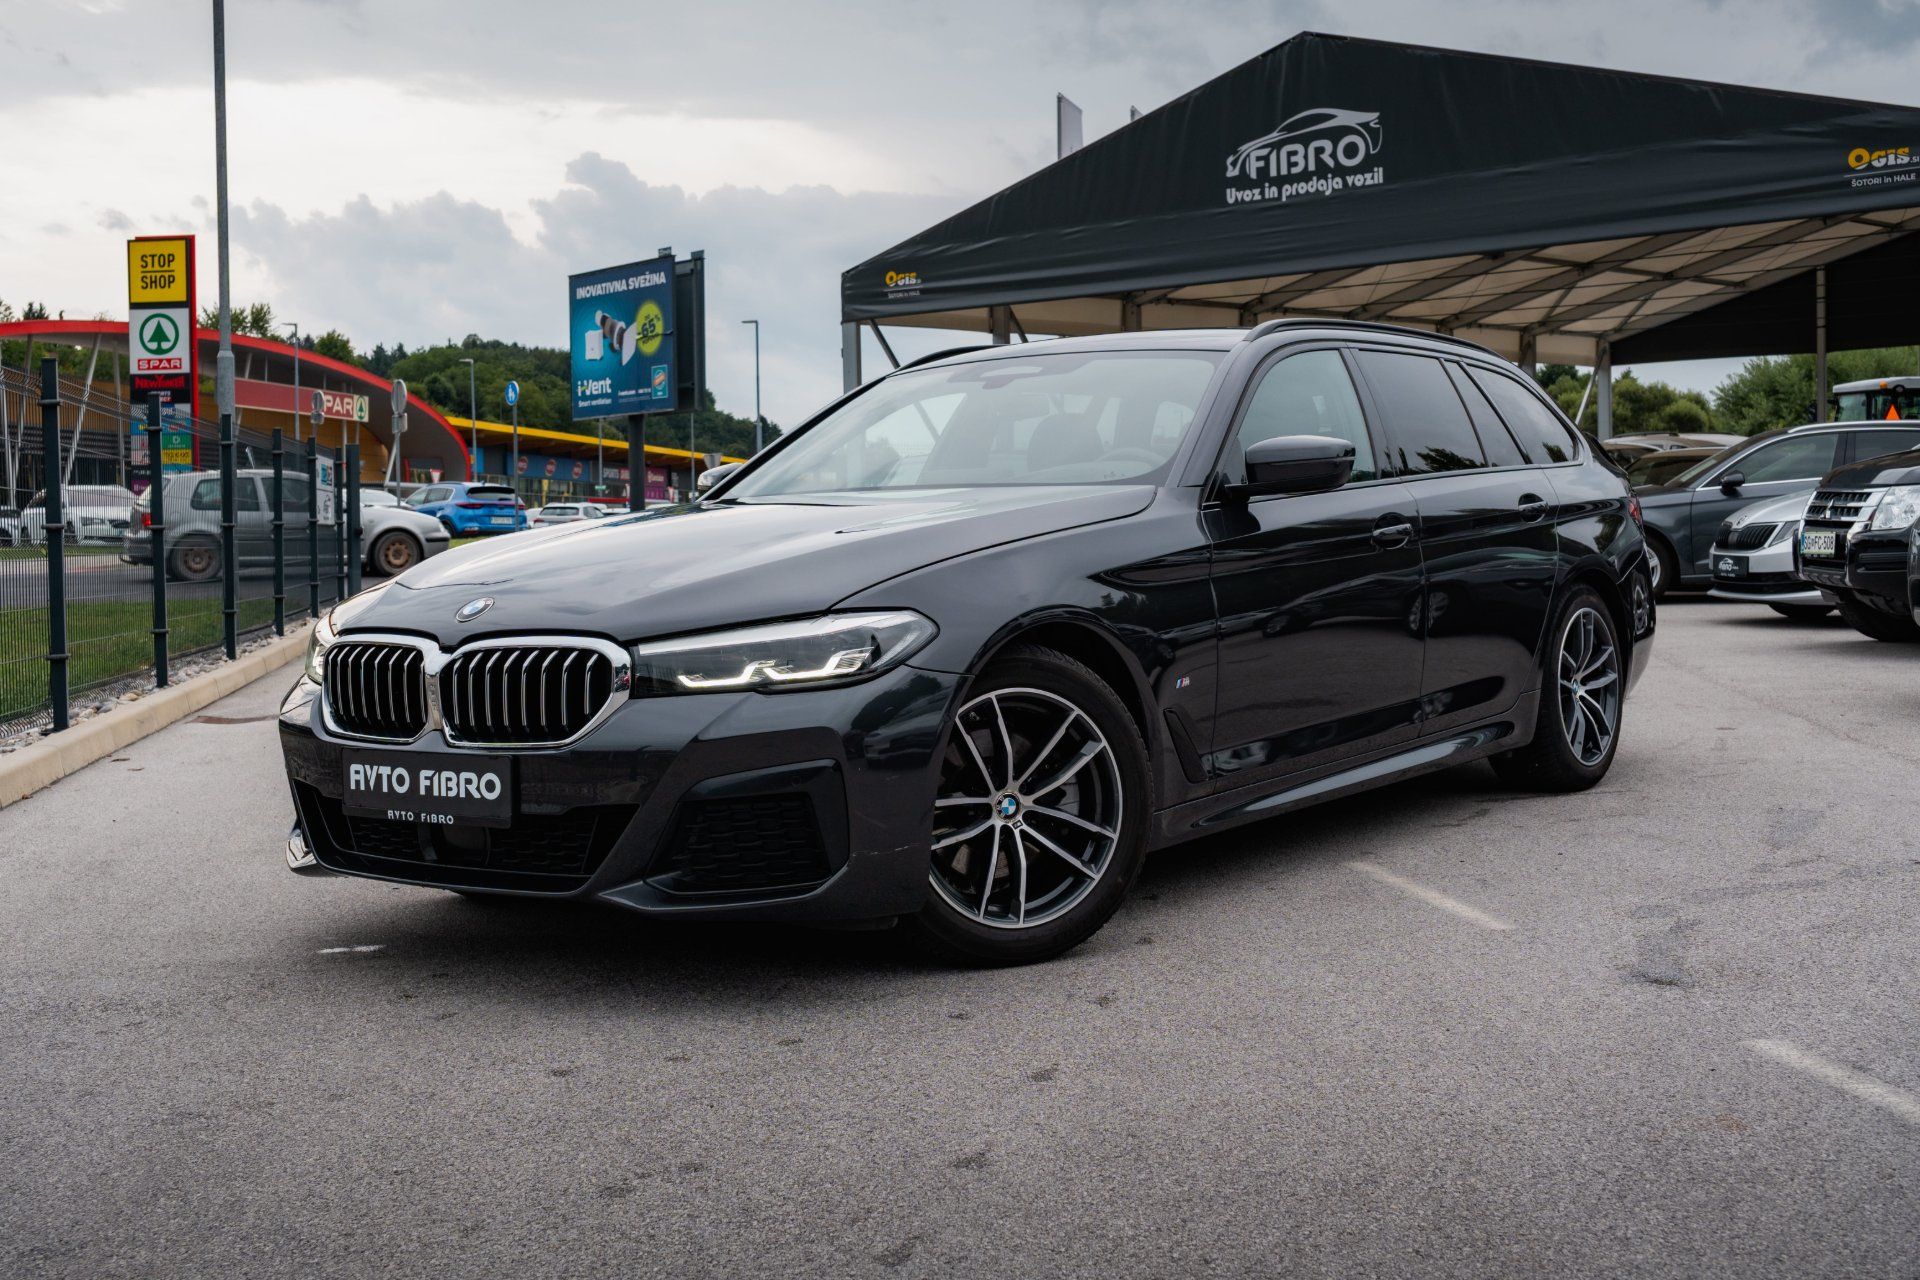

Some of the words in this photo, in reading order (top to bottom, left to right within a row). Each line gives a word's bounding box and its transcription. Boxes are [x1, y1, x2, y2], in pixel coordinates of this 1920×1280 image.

[1249, 134, 1366, 179] FIBRO
[1226, 187, 1261, 204] Uvoz
[1264, 182, 1278, 199] in
[1282, 173, 1343, 201] prodaja
[1346, 166, 1383, 188] vozil
[1894, 173, 1916, 183] HALE
[140, 253, 175, 269] STOP
[140, 274, 176, 290] SHOP
[576, 279, 628, 300] INOVATIVNA
[628, 271, 666, 290] SVEŽINA
[139, 359, 181, 369] SPAR
[318, 394, 353, 415] PAR
[350, 763, 410, 794] AVTO
[419, 769, 502, 801] FIBRO
[388, 810, 414, 822] AVTO
[421, 812, 454, 825] FIBRO
